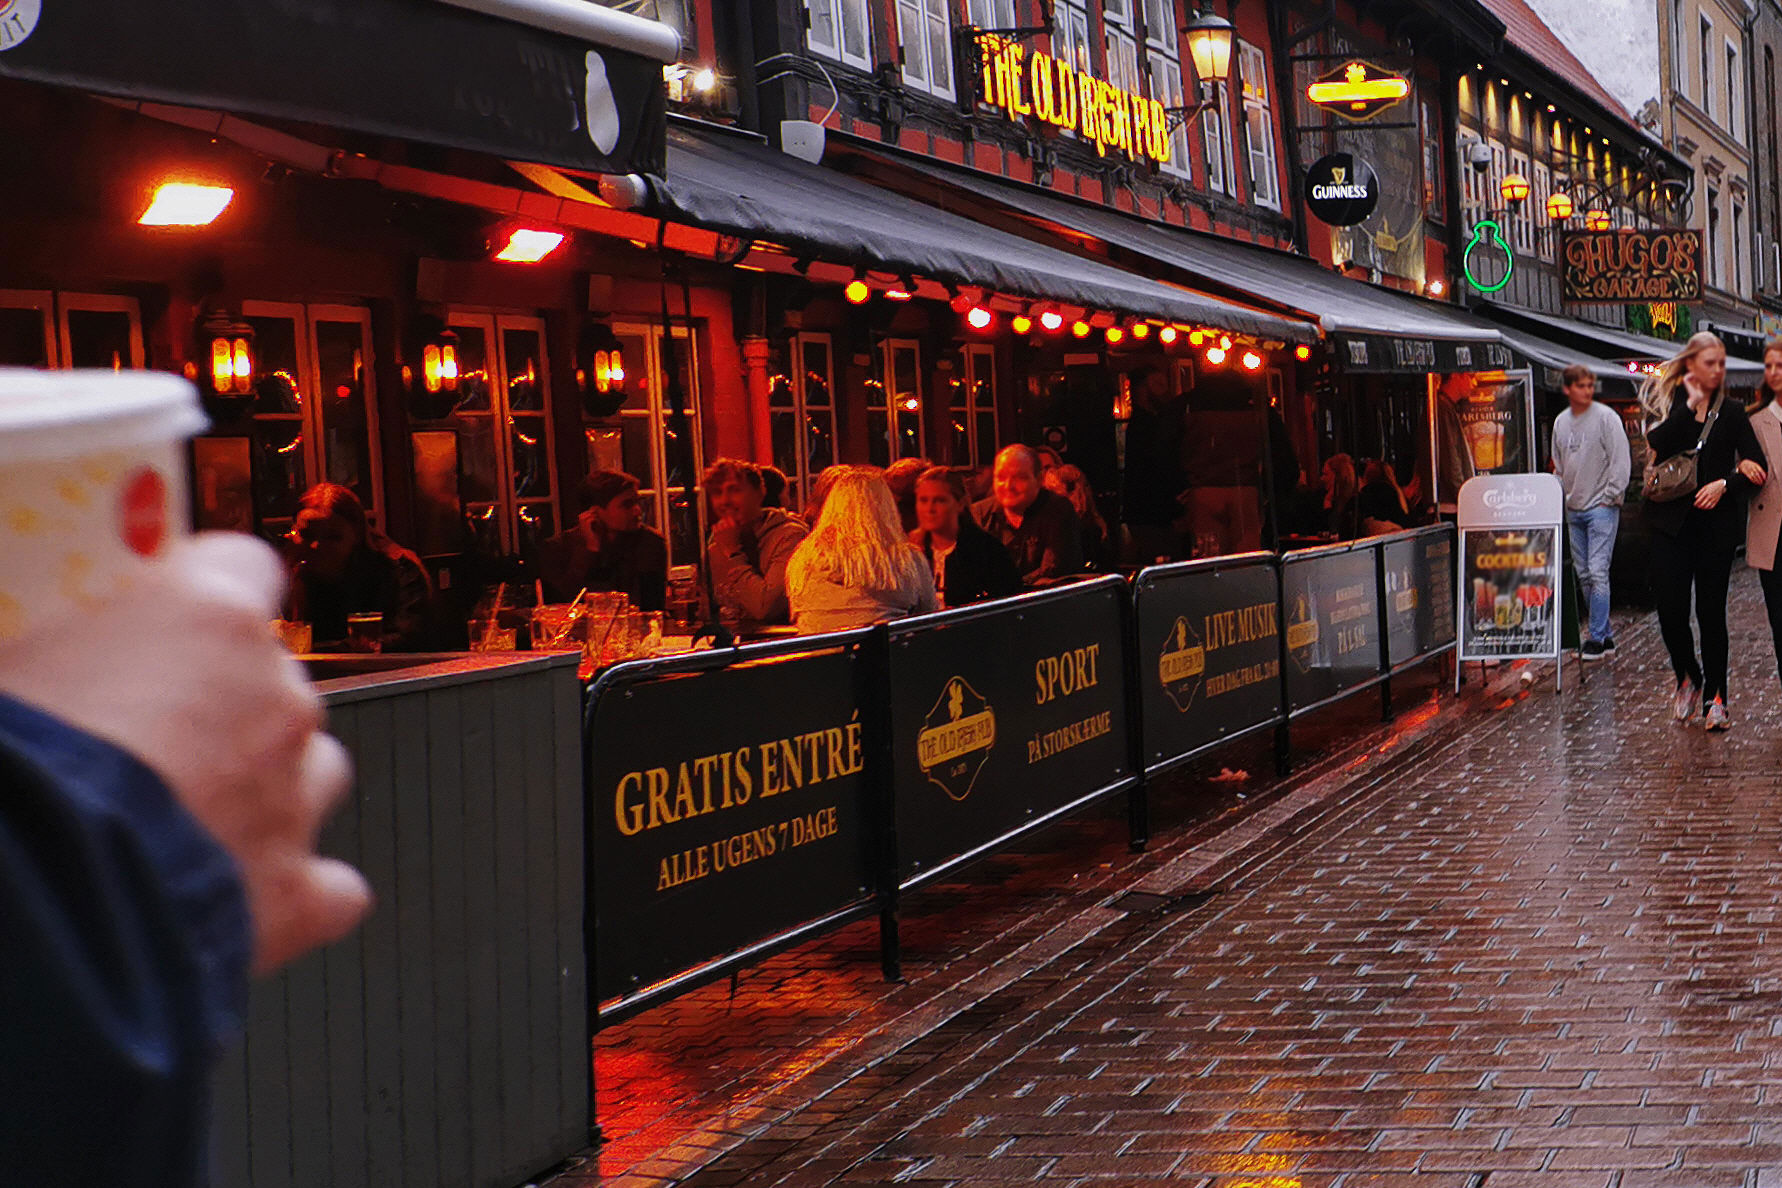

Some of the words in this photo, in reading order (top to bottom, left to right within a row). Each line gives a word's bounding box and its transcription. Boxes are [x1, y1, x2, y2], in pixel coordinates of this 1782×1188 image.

[975, 33, 1031, 121] THE
[1031, 50, 1077, 129] OLD
[1079, 71, 1134, 161] IRISH
[1131, 94, 1169, 162] PUB
[1312, 184, 1367, 199] GUINNESS
[1566, 232, 1696, 278] HUGO'S
[1593, 277, 1672, 298] GARAGE
[1483, 489, 1536, 509] Carlsberg
[1476, 553, 1545, 569] COCKTAILS
[1205, 610, 1236, 652] LIVE
[1238, 602, 1277, 643] MUSIK
[1035, 643, 1100, 705] SPORT
[1027, 733, 1042, 764] PÅ
[614, 747, 752, 836] GRATIS
[759, 708, 864, 798] ENTRÉ
[656, 845, 709, 891] ALLE
[712, 825, 776, 872] UGENS
[778, 822, 788, 850] 7
[792, 807, 838, 847] DAGE
